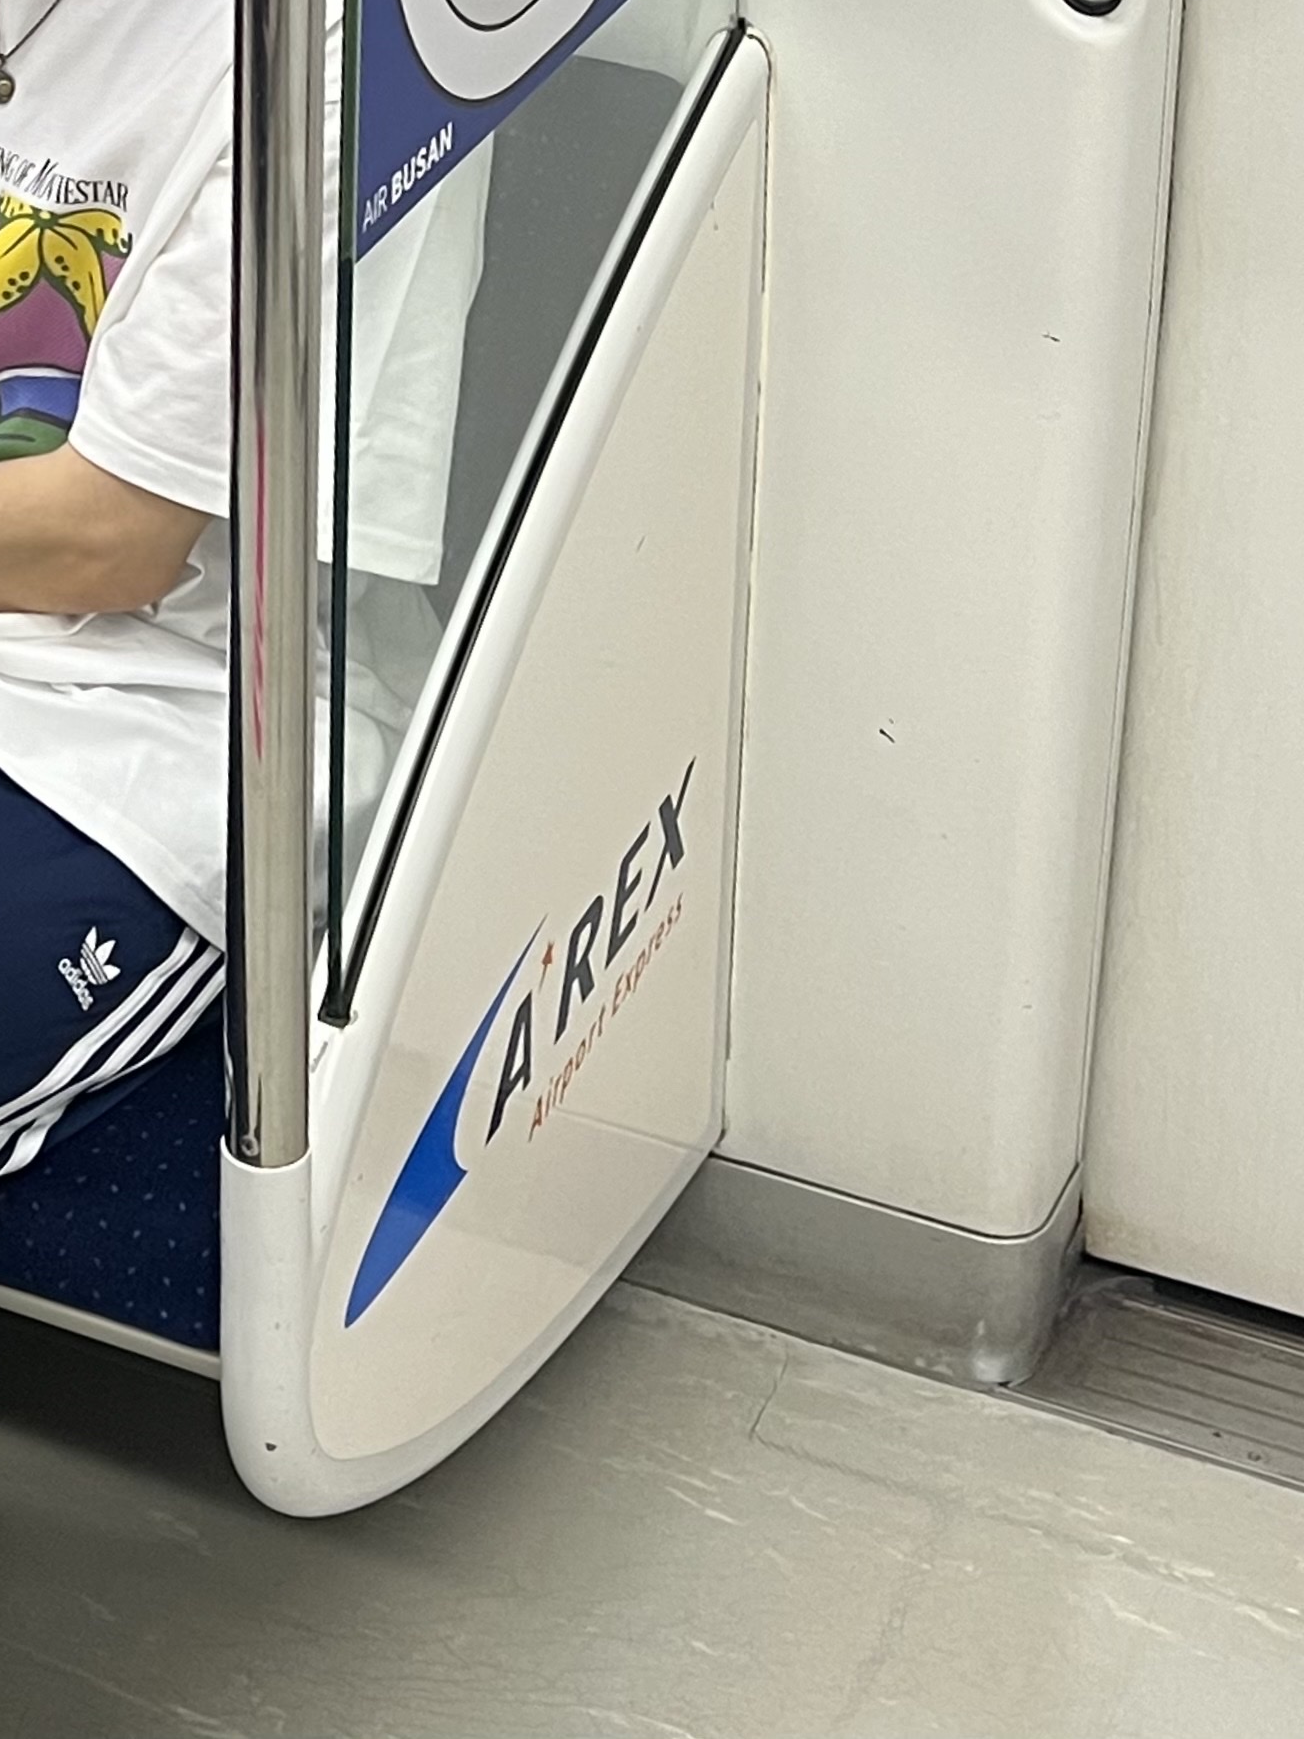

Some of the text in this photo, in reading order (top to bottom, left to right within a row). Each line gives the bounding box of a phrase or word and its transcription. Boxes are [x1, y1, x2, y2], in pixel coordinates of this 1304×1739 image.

[362, 121, 453, 234] AIR BUSAN
[528, 892, 684, 1143] Airport Express
